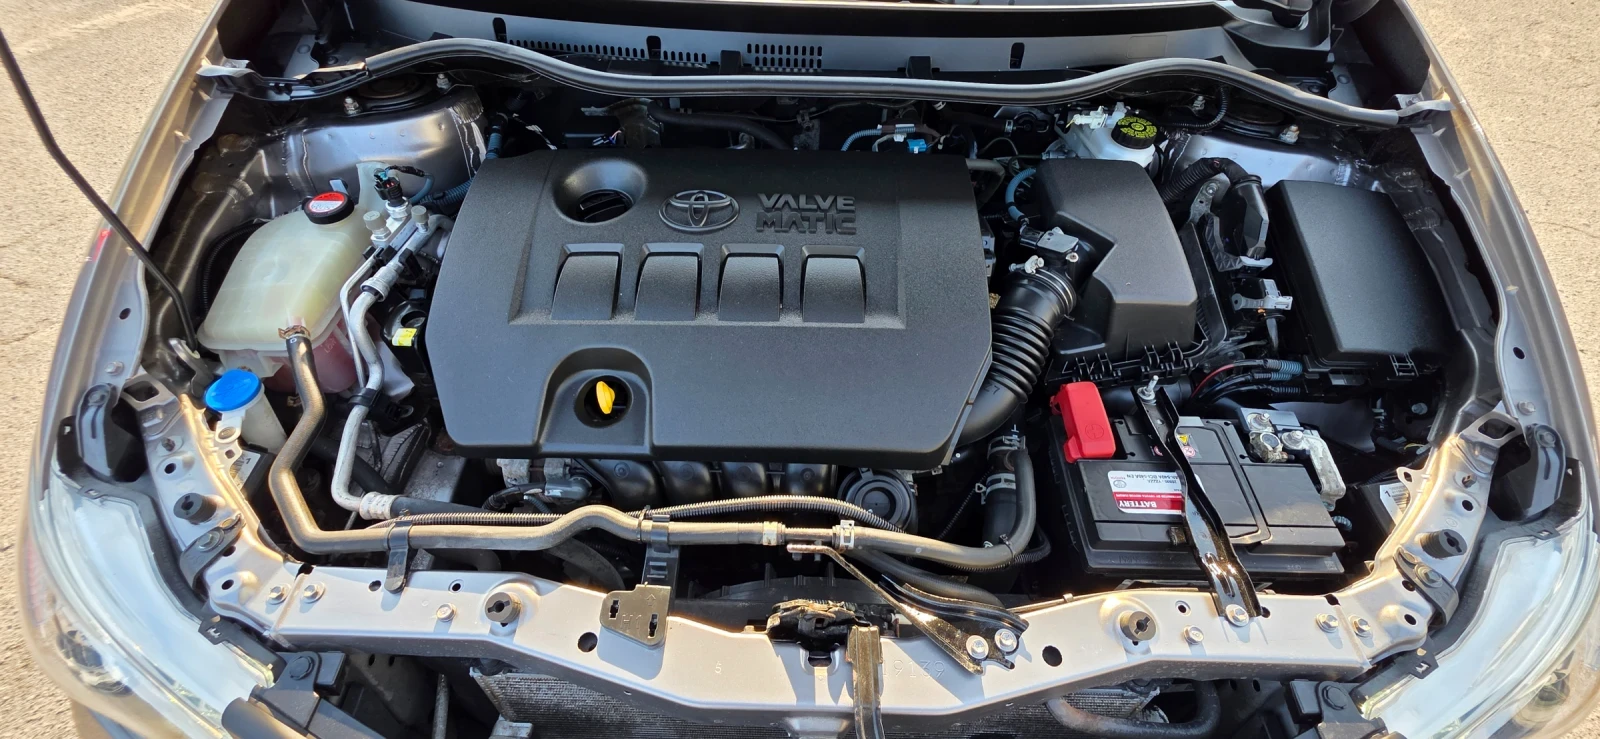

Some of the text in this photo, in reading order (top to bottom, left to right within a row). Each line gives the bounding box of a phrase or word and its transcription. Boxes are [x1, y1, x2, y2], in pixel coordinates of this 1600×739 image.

[757, 193, 856, 212] VALVE
[756, 211, 857, 234] MATIC
[1119, 500, 1157, 508] BATTERY
